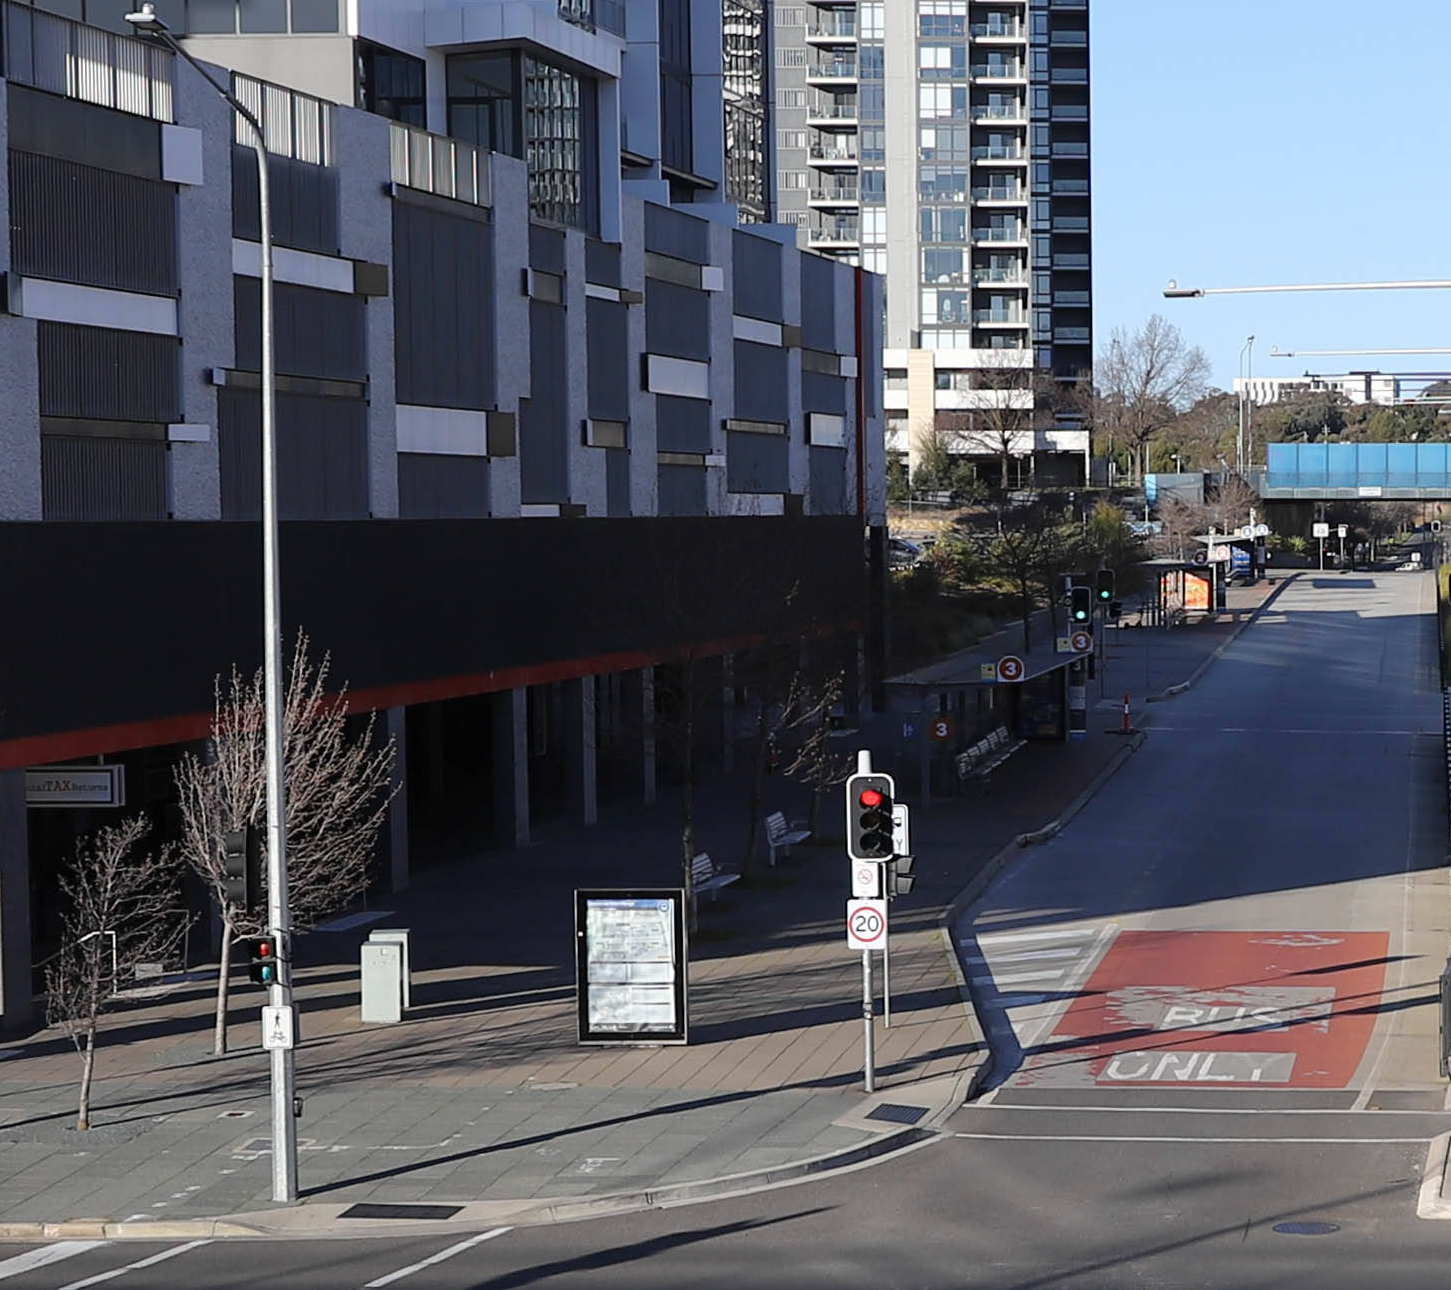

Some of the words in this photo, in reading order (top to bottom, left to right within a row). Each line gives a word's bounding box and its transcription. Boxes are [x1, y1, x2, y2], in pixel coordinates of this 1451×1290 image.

[1076, 636, 1086, 648] 3
[1005, 662, 1017, 676] 3
[935, 722, 948, 737] 3
[855, 915, 880, 932] 20
